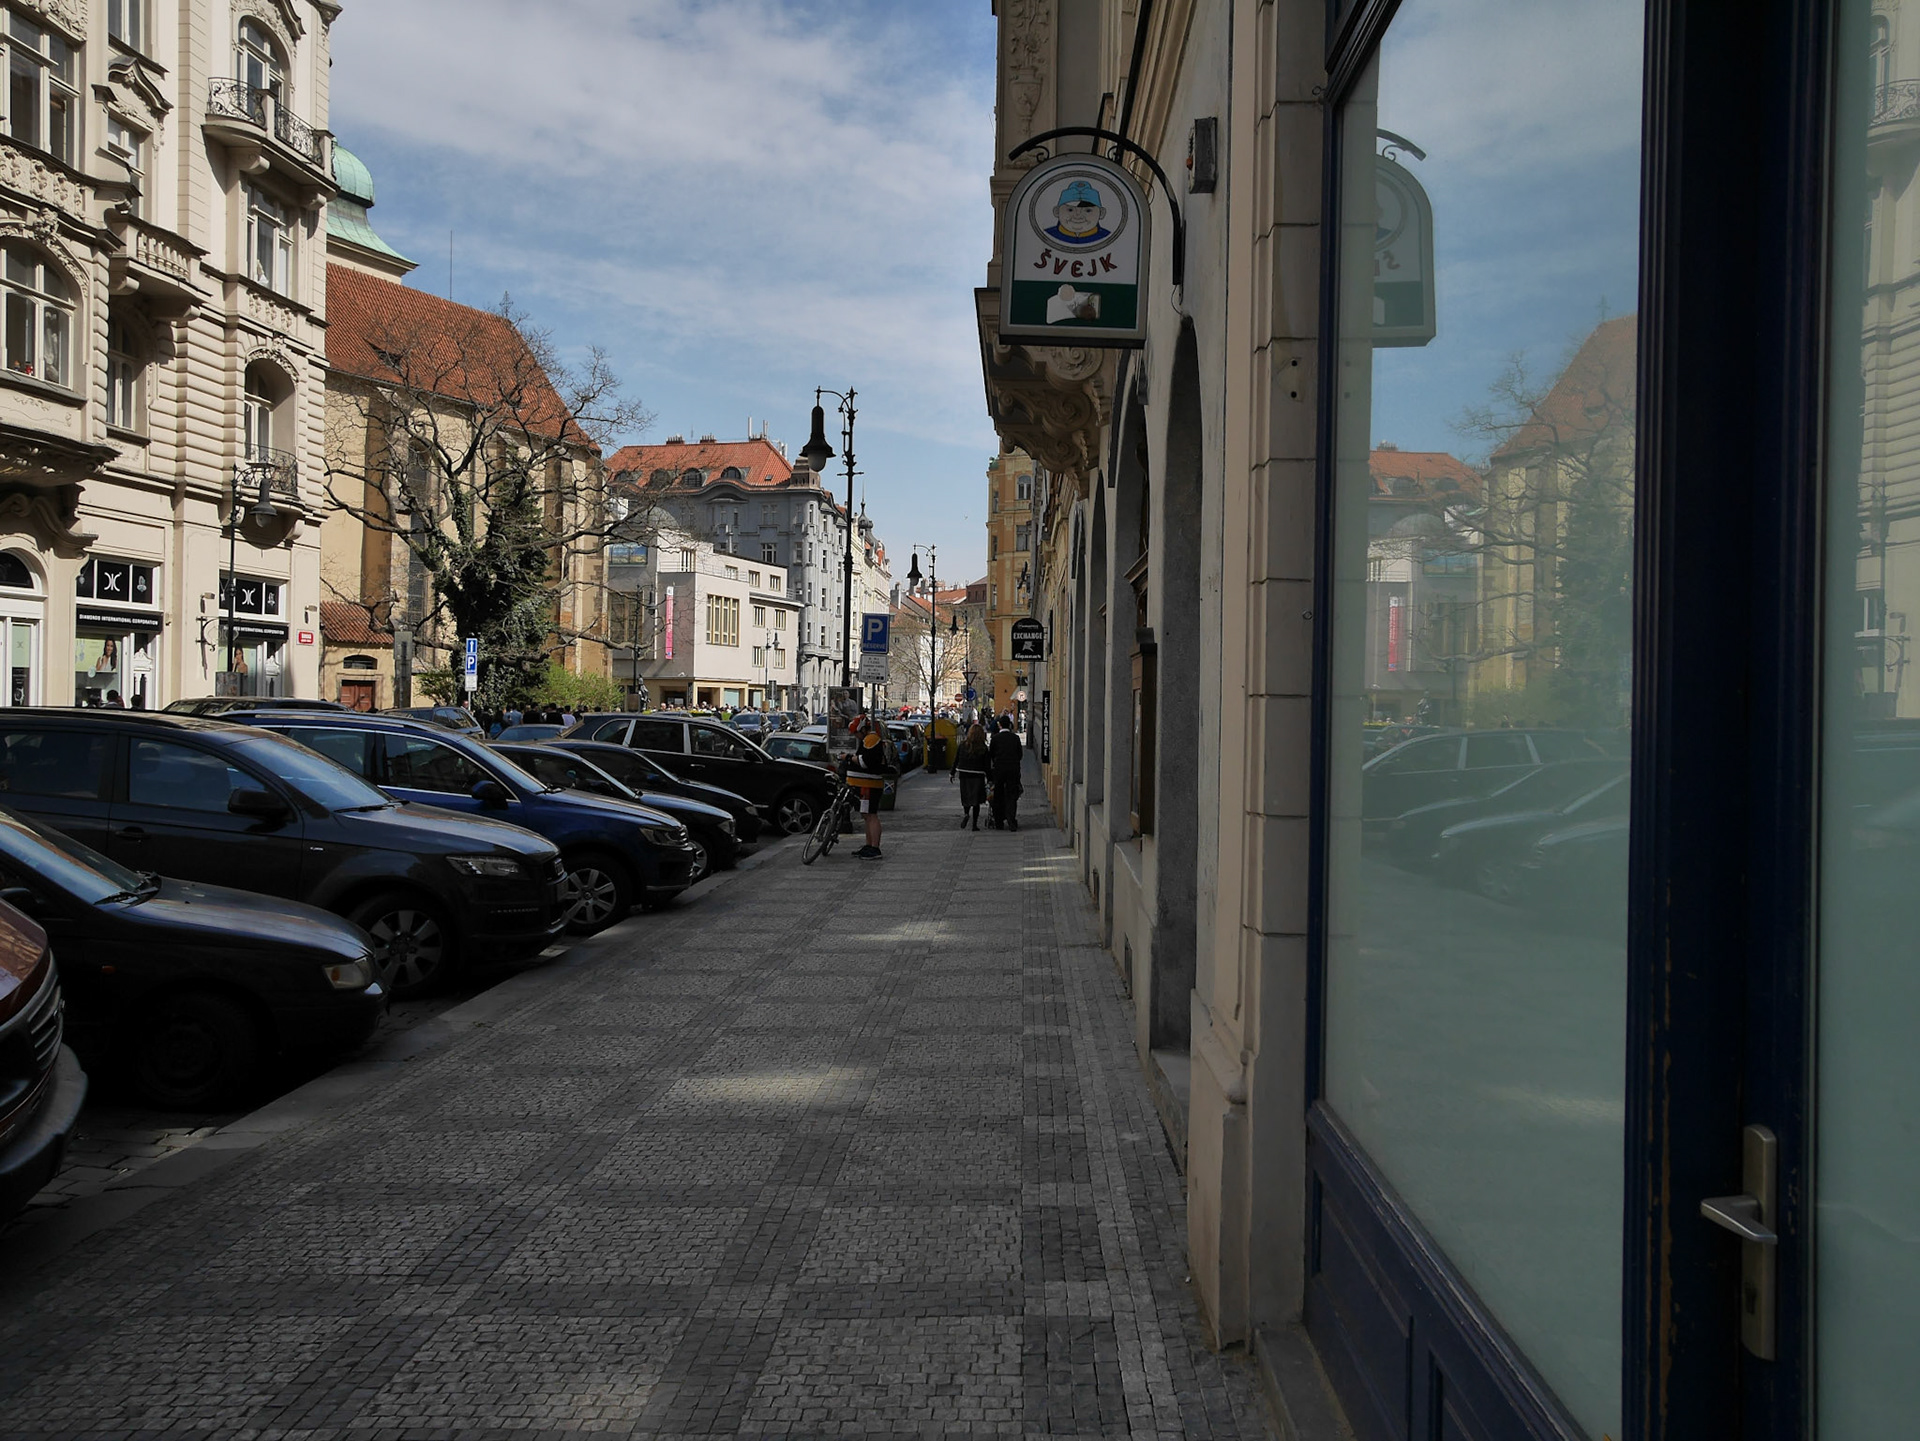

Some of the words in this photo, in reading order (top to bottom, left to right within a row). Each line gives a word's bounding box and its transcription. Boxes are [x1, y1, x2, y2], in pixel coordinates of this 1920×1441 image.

[1033, 248, 1118, 278] ŠVEJK
[101, 615, 131, 623] INTERNATIONAL
[867, 619, 883, 641] P
[1013, 632, 1043, 640] EXCHANGE
[468, 656, 475, 669] P
